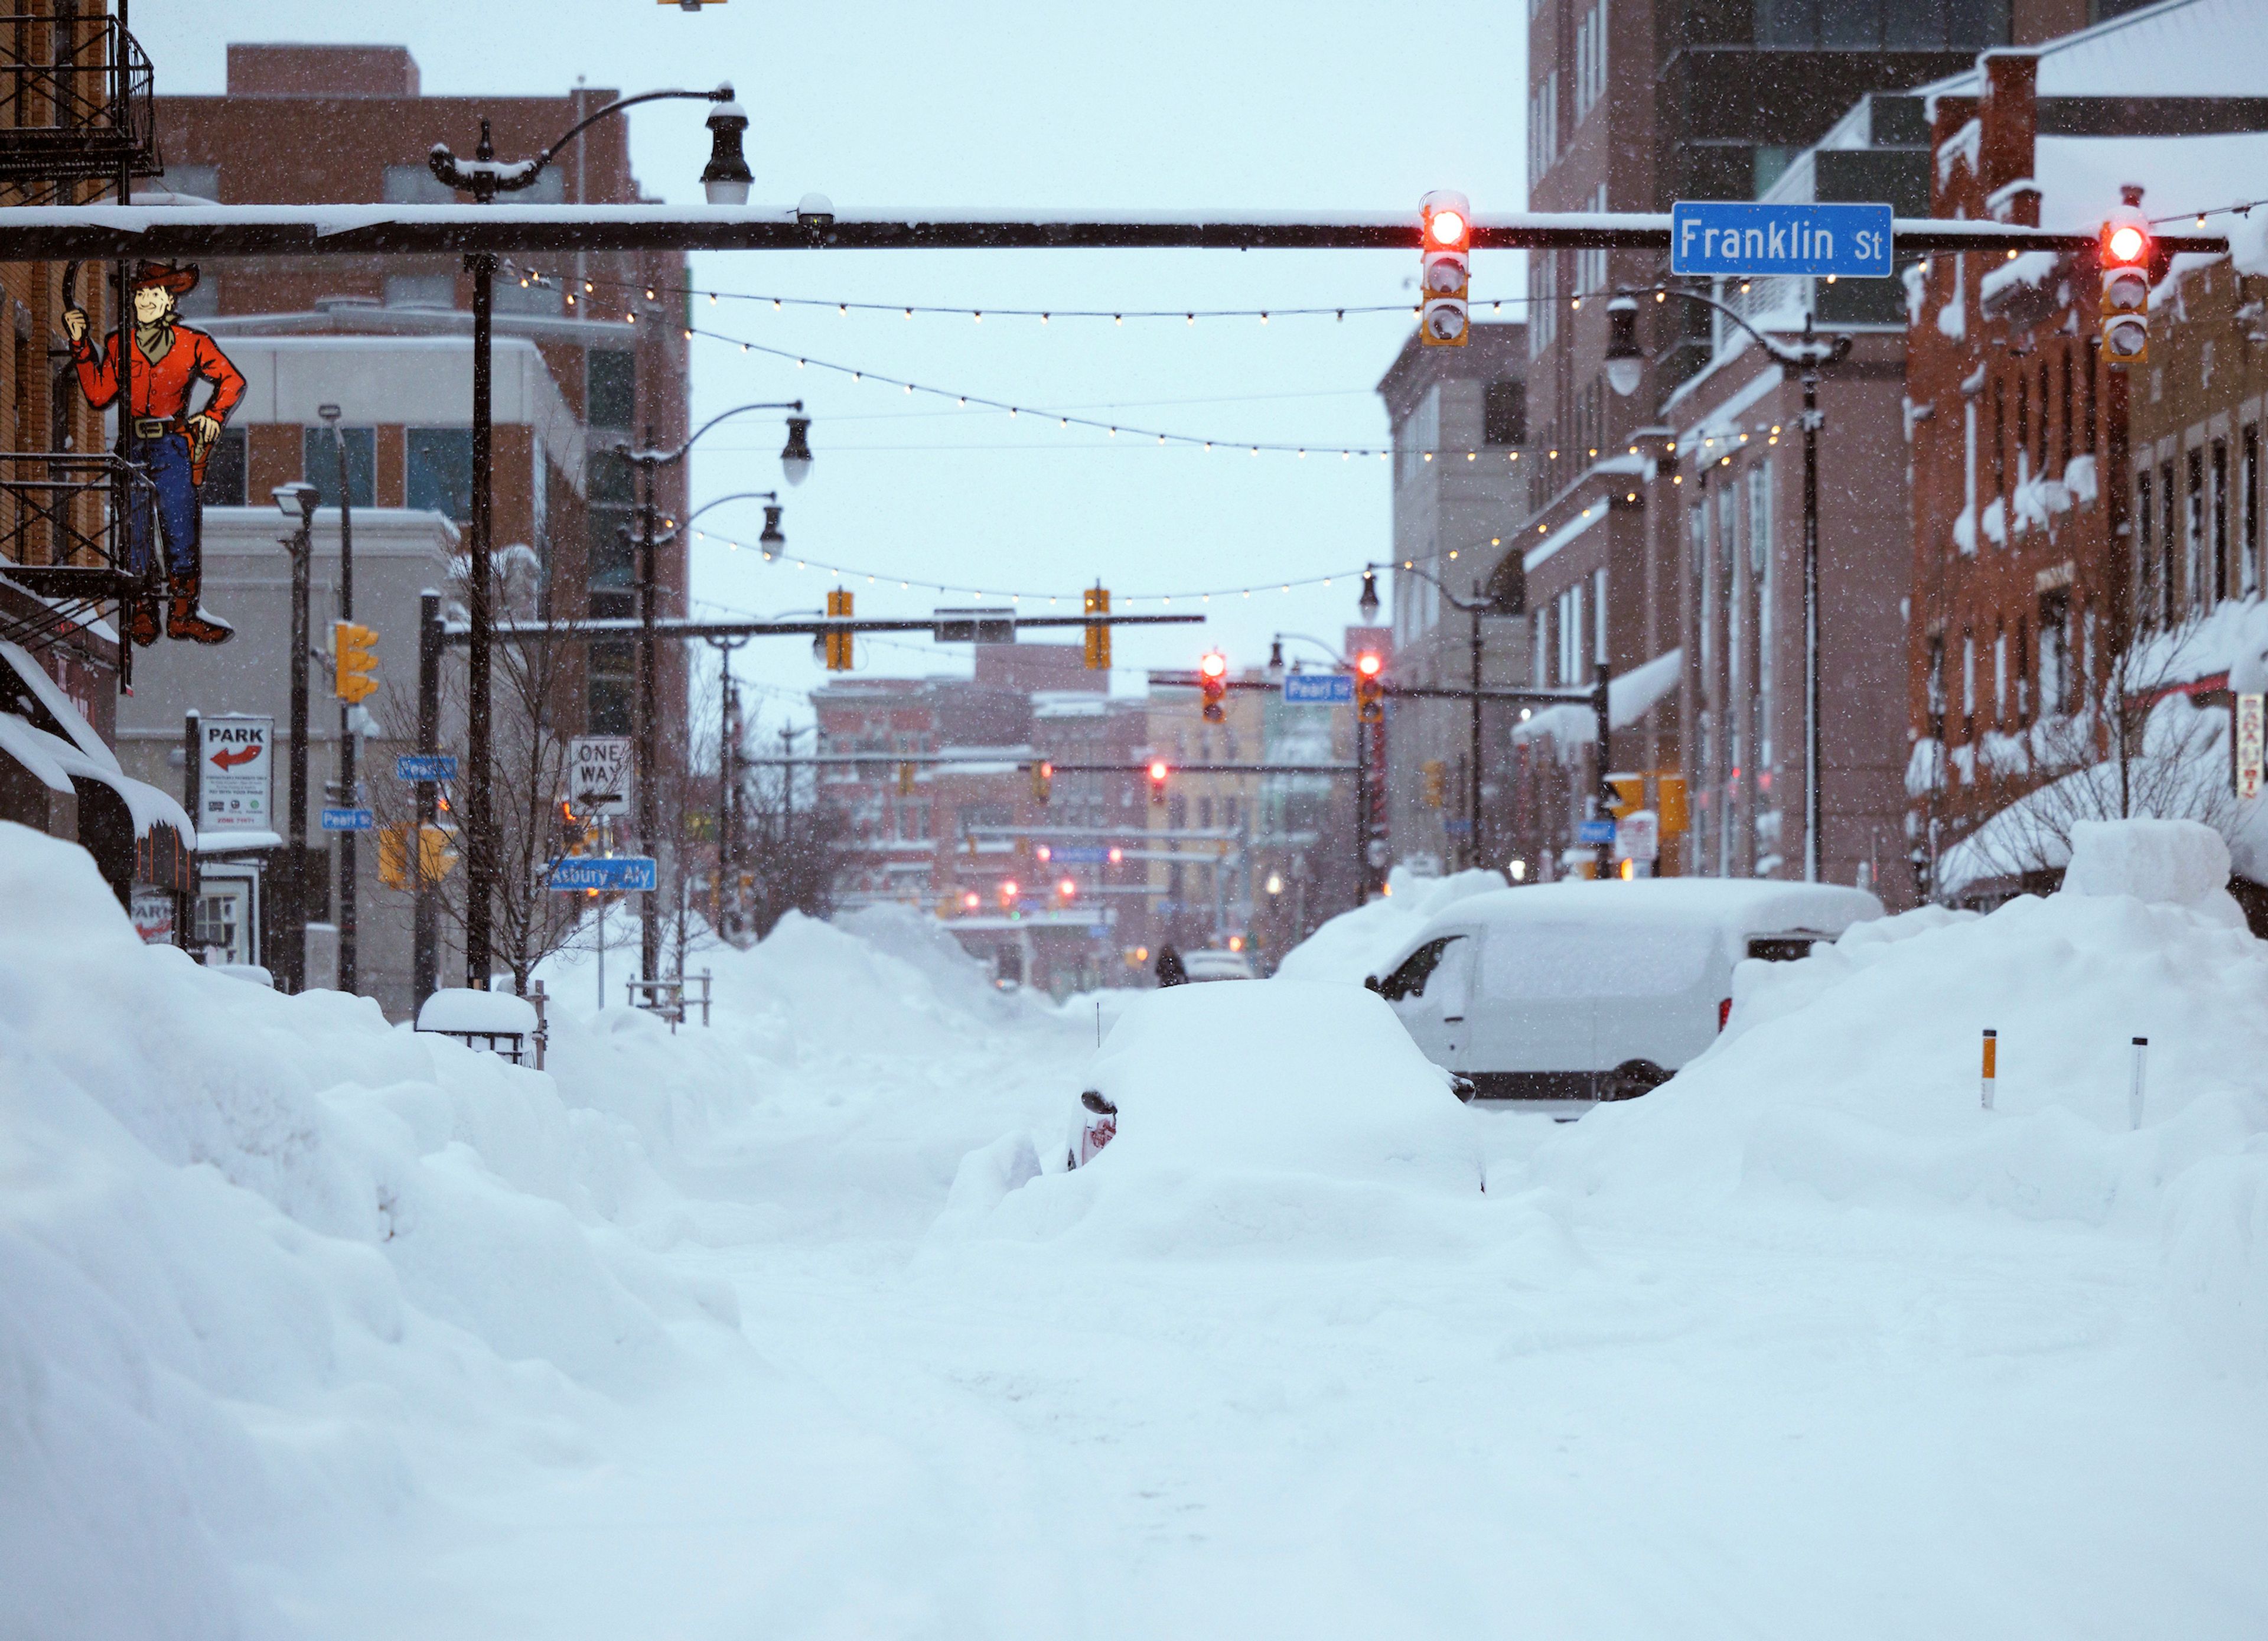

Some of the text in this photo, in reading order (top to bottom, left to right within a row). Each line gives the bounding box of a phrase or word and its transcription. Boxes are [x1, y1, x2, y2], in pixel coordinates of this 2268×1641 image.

[1682, 219, 1883, 260] Franklin St
[208, 728, 264, 743] PARK
[580, 745, 620, 762] ONE
[581, 766, 621, 783] WAY
[324, 812, 356, 826] Pearl
[551, 865, 650, 888] Asbury Aly
